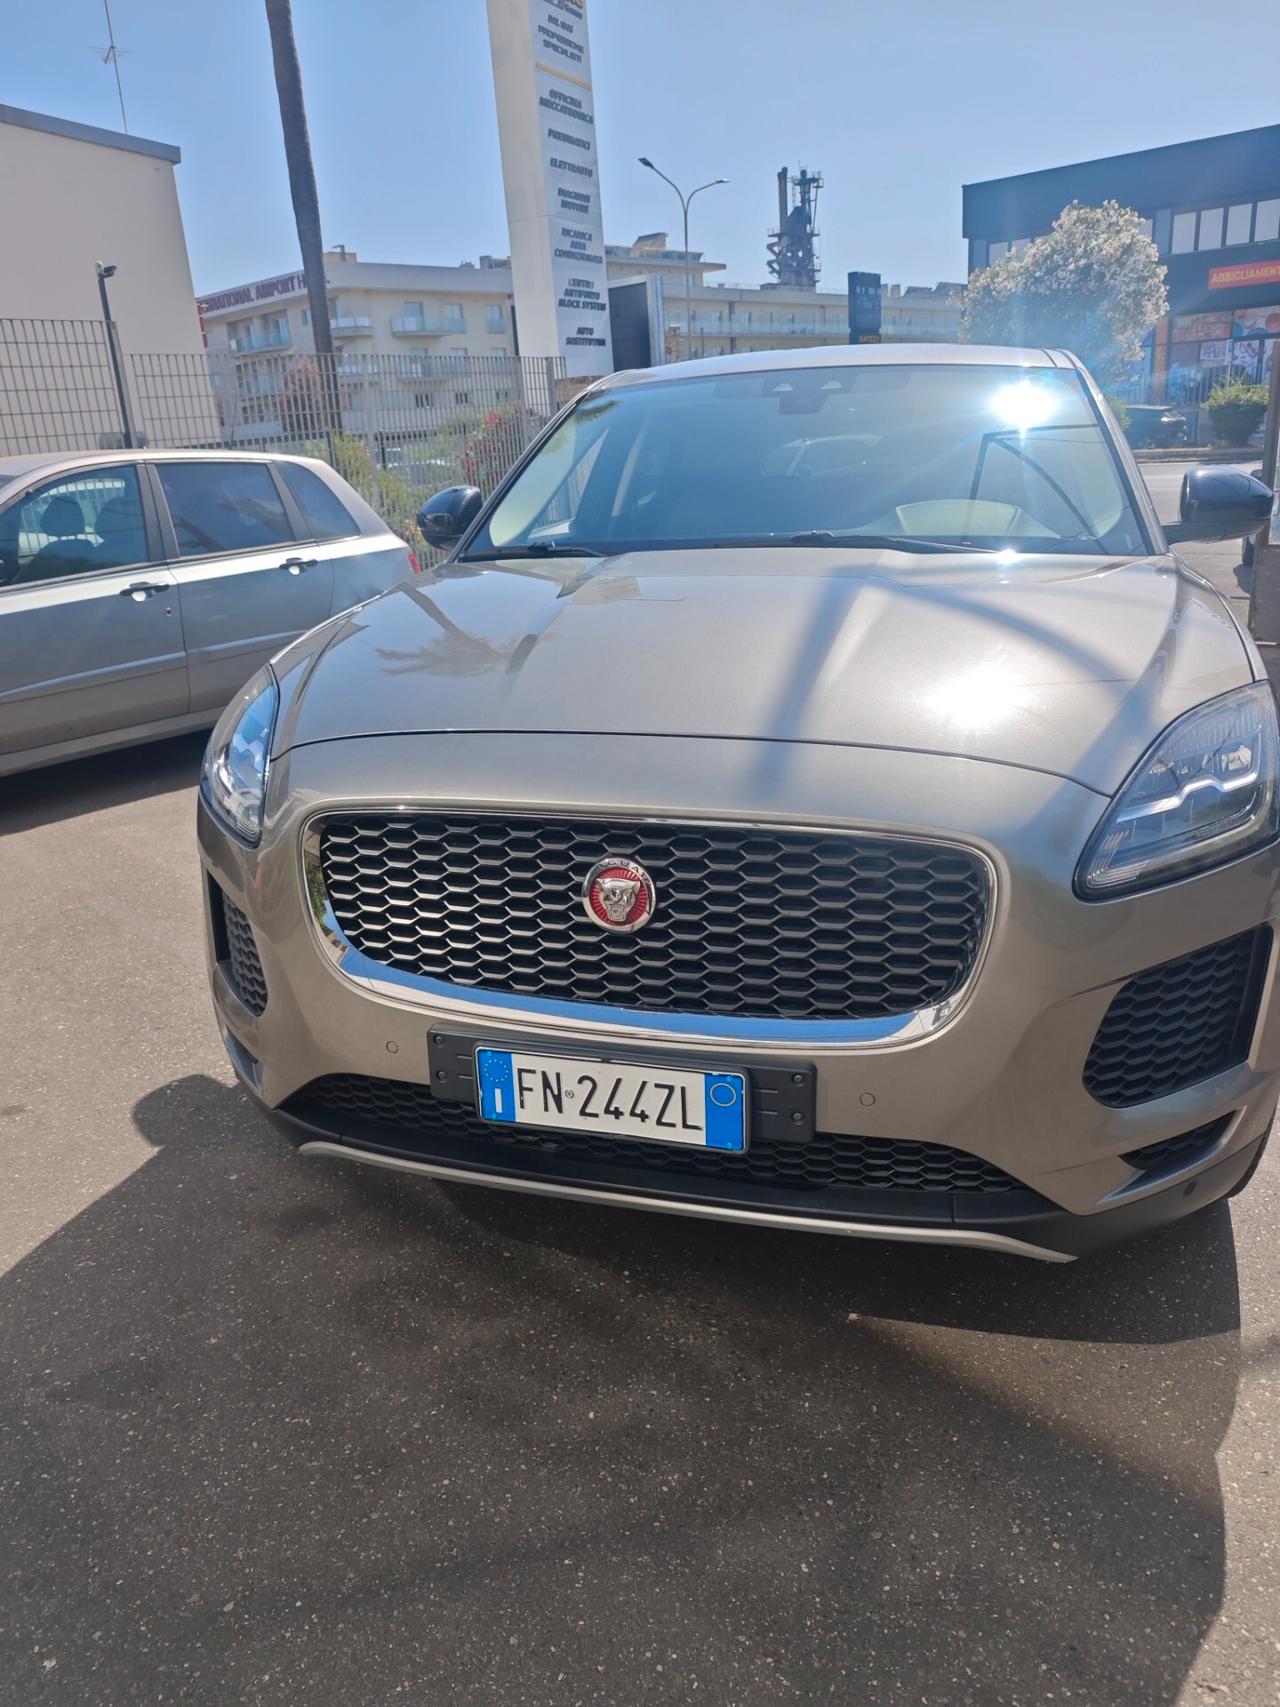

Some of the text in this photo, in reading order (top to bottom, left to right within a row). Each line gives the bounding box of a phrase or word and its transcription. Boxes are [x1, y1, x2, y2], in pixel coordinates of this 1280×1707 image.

[549, 89, 583, 109] OFFICINA
[539, 96, 594, 125] MECCATRONICA
[550, 157, 593, 178] ELETTRAUTO
[557, 187, 590, 204] DIAGNOSI
[255, 274, 296, 301] AIRPORT
[558, 298, 607, 312] BLOCK SYSTEM
[576, 326, 594, 336] AUTO
[565, 337, 607, 347] SOSTITUTIVA
[517, 1067, 703, 1131] FN 244ZL
